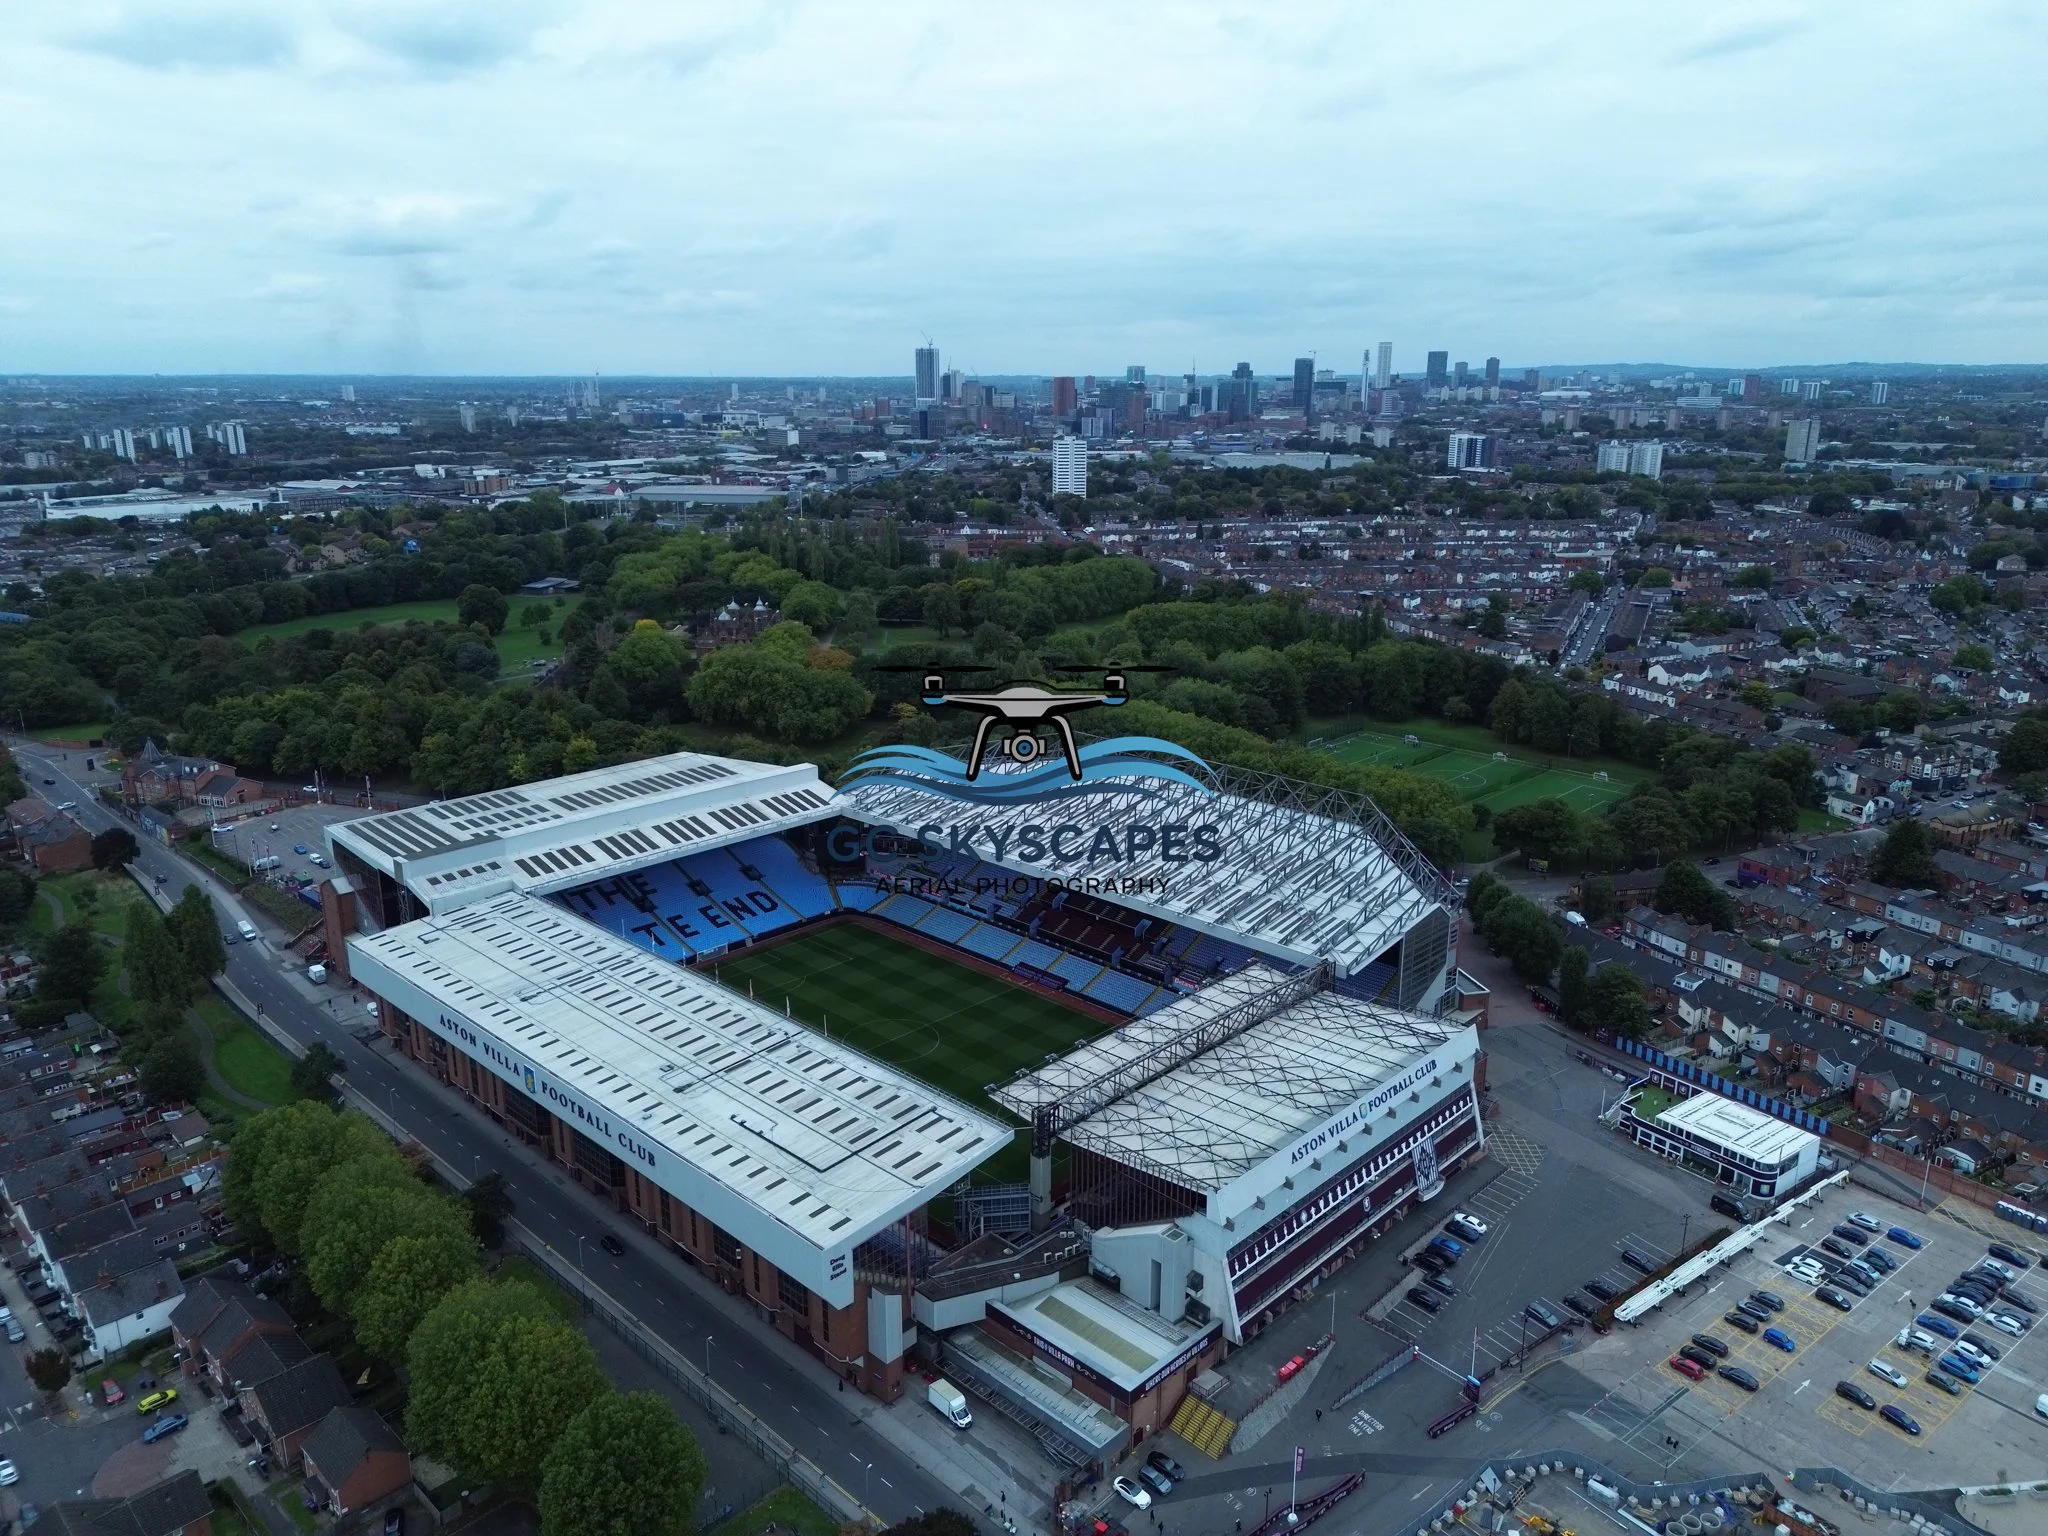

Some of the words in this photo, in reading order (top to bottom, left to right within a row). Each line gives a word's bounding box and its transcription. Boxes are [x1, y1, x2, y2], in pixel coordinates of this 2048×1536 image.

[568, 872, 658, 911] THE
[698, 890, 778, 929] END
[439, 1013, 477, 1047] ASTON
[483, 1041, 521, 1077] VILLA
[541, 1080, 612, 1137] FOOTBALL
[618, 1132, 657, 1168] CLUB
[1290, 1134, 1327, 1165] ASTON
[1328, 1111, 1359, 1138] VILLA
[1367, 1077, 1416, 1112] FOOTBALL
[1414, 1059, 1438, 1082] CLUB
[829, 1254, 846, 1266] Doug
[830, 1267, 847, 1281] Stand
[1048, 1345, 1062, 1360] VILLA
[1061, 1353, 1075, 1369] PARK
[1351, 1415, 1375, 1435] PLAYERS
[1358, 1409, 1385, 1431] DIRECTORS
